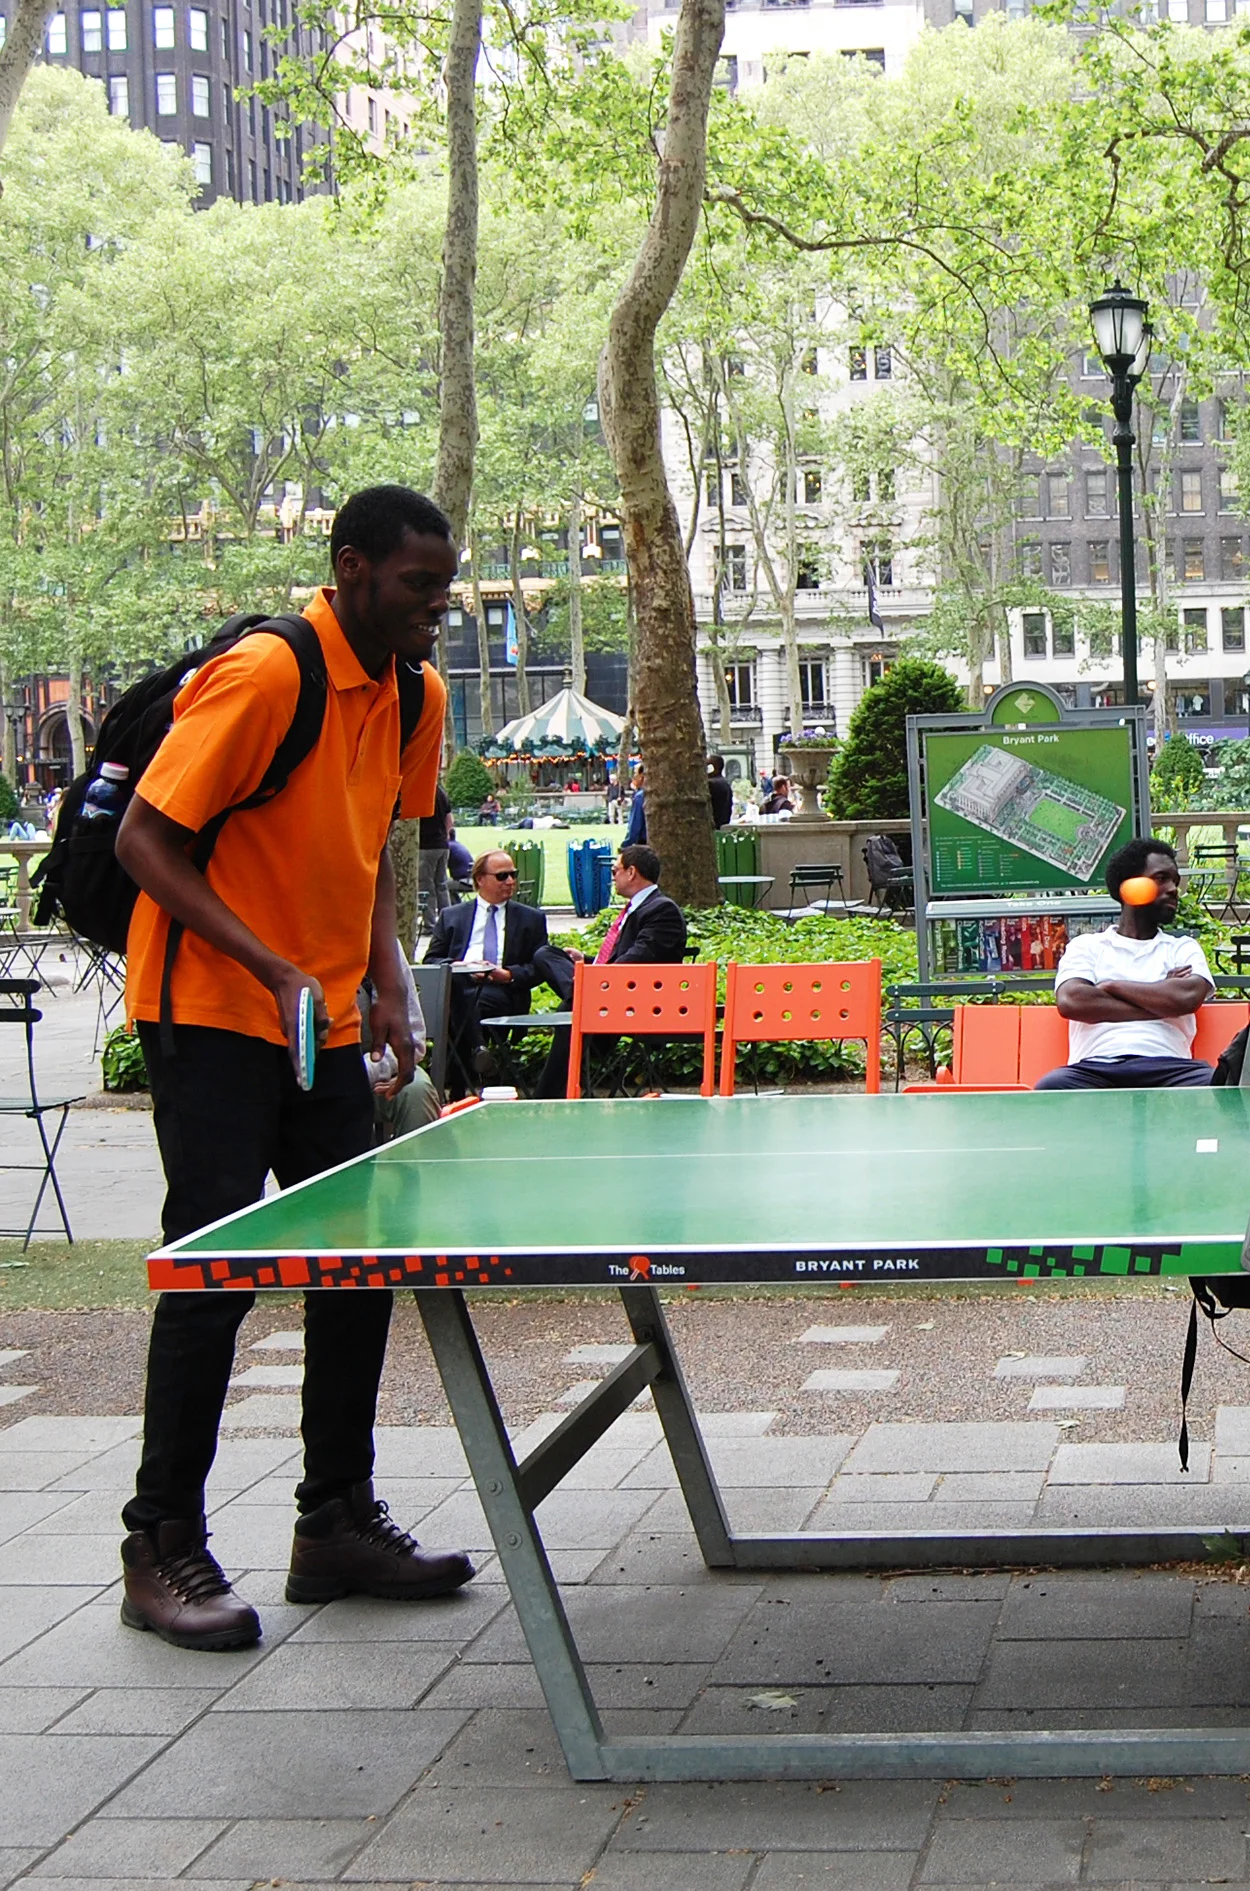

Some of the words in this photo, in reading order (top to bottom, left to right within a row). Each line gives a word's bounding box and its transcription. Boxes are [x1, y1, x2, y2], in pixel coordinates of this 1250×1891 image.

[1003, 735, 1035, 745] Bryant
[1037, 734, 1060, 743] Park
[1184, 732, 1215, 745] ffice
[608, 1264, 630, 1276] The
[650, 1263, 686, 1276] Tables
[795, 1260, 866, 1272] BRYANT
[872, 1258, 920, 1271] PARK
